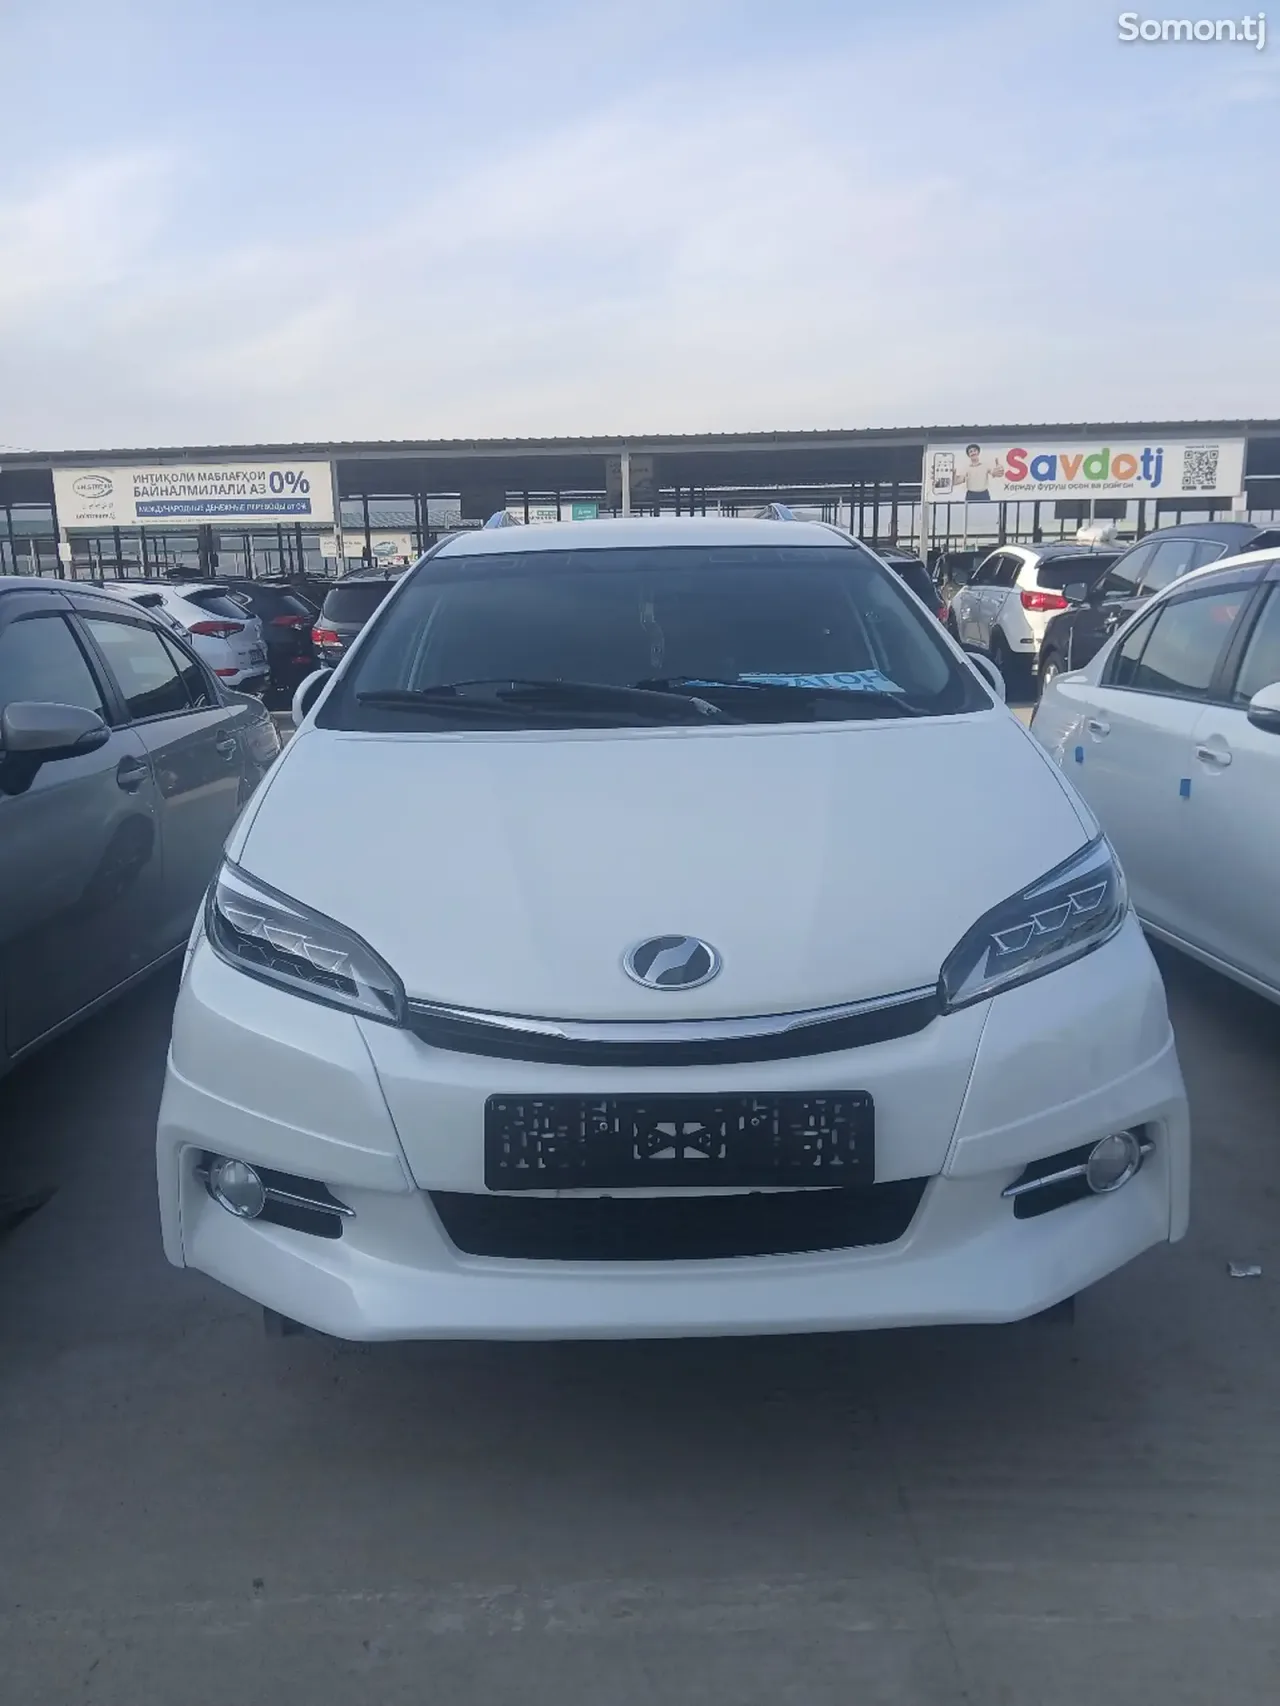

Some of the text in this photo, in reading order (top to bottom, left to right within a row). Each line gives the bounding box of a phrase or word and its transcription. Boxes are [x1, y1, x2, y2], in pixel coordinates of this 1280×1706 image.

[1005, 448, 1163, 488] Savdo.tj
[134, 483, 267, 498] БАЙНАЛМИЛАЛИ АЗ
[269, 471, 310, 494] 0%
